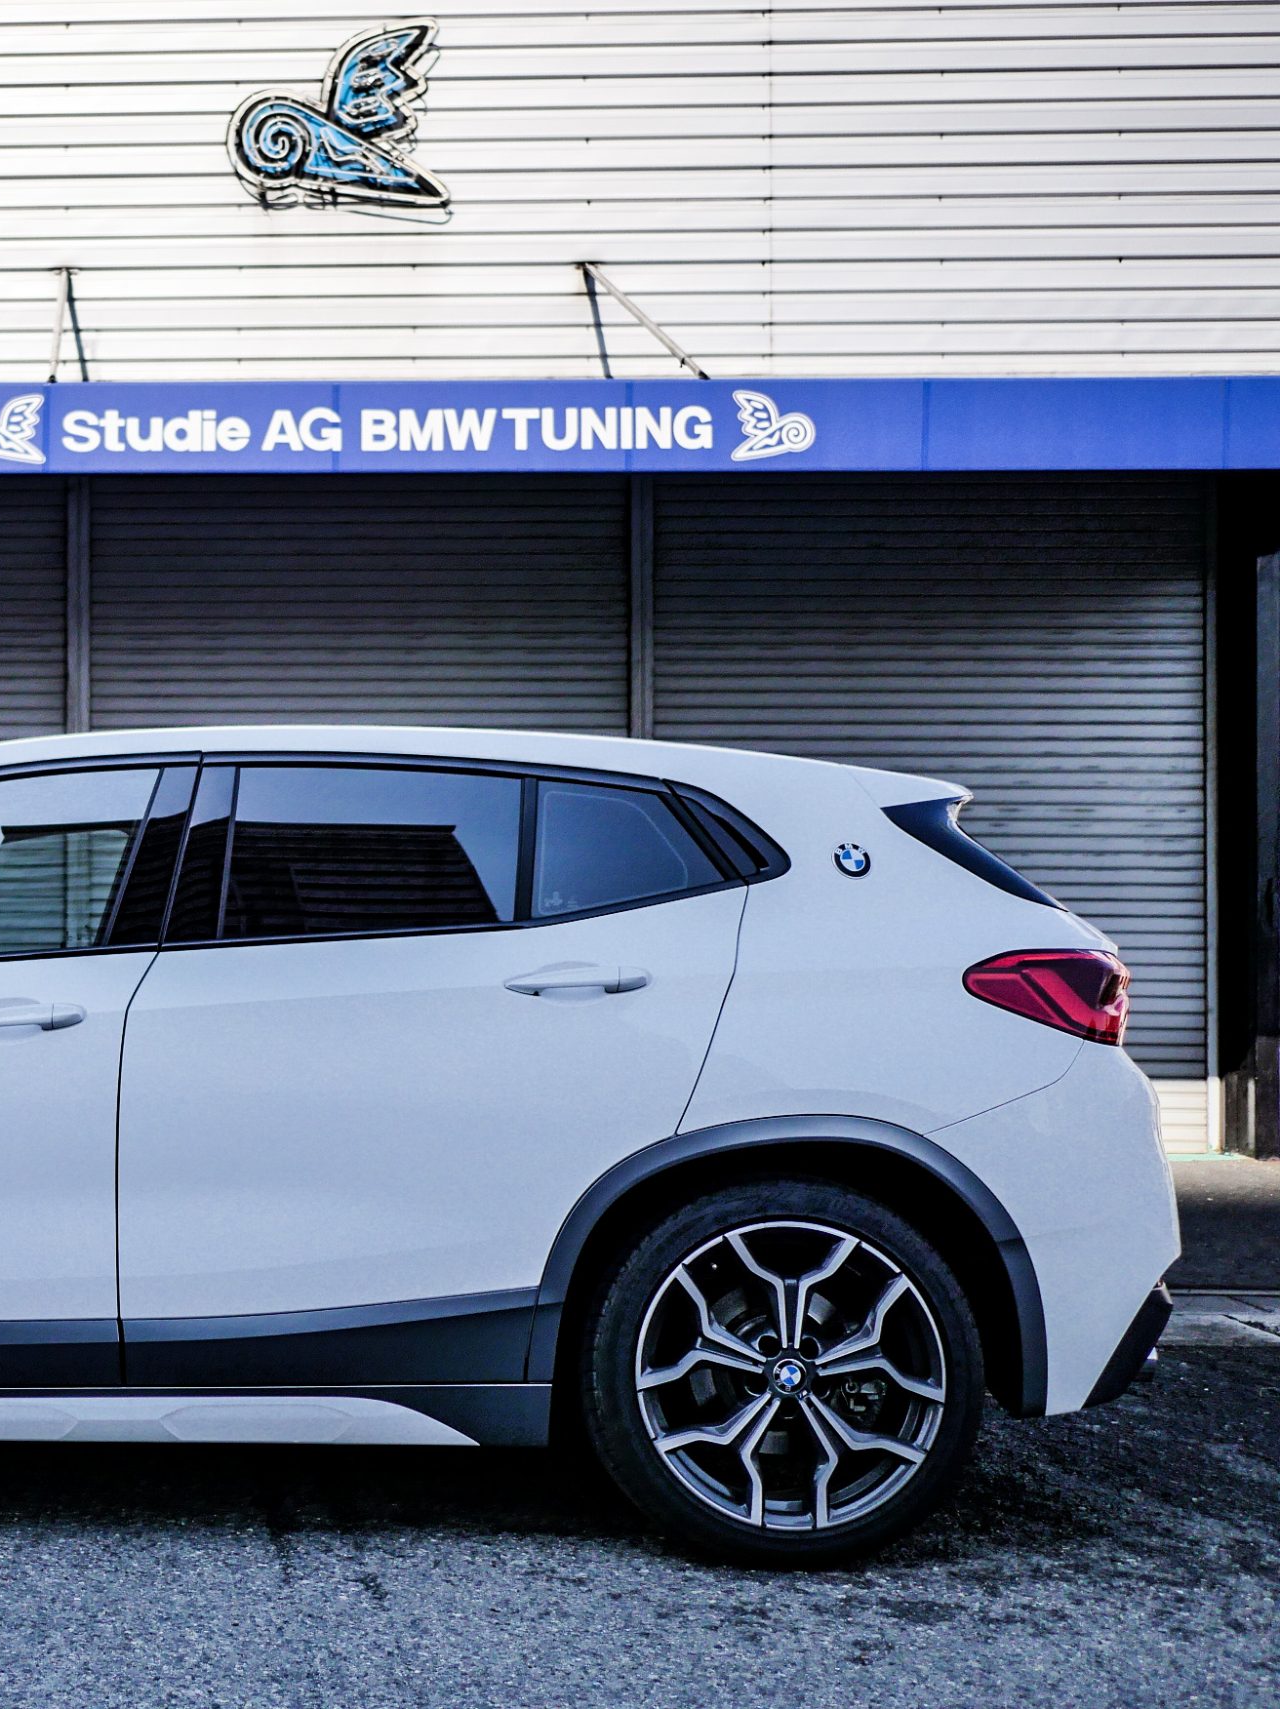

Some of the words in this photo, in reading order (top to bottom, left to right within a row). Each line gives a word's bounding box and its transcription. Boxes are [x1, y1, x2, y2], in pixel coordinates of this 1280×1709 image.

[62, 408, 251, 453] Studie
[261, 407, 343, 453] AG
[360, 408, 497, 452] BMW
[501, 405, 713, 451] TUNING
